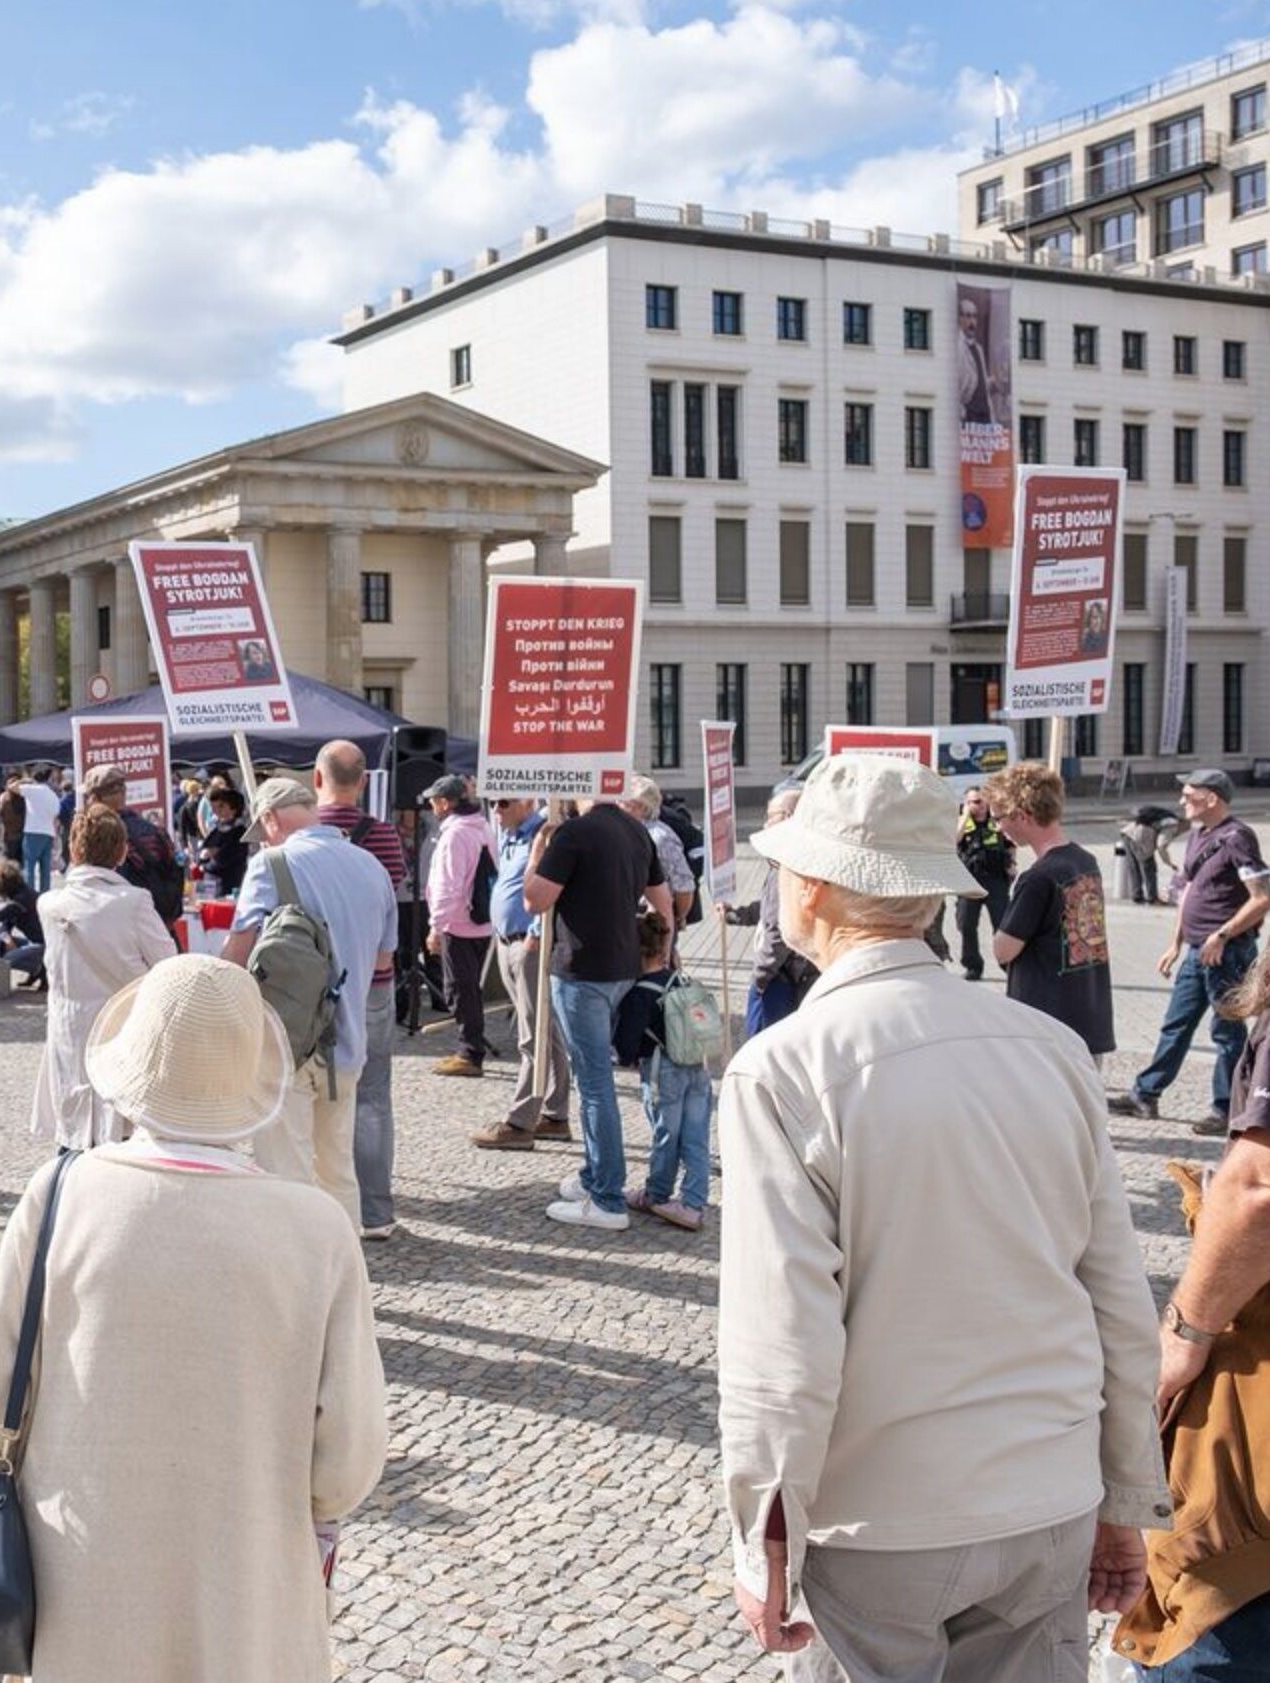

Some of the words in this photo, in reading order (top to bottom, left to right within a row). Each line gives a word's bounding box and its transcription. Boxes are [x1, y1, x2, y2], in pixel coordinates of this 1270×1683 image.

[1032, 512, 1062, 530] FREE
[1065, 508, 1112, 528] BOGDAN
[1039, 528, 1104, 550] SYROTJUK!
[152, 574, 191, 590] FREE
[192, 572, 249, 587] BOGDAN
[166, 586, 243, 604] SYROTJUK!
[506, 618, 554, 631] STOPPT
[558, 618, 585, 630] DEN
[587, 617, 625, 630] KRIEG
[516, 639, 566, 654] Против
[568, 637, 614, 651] войны
[521, 659, 564, 674] Проти
[553, 678, 614, 691] Durdurun
[1012, 681, 1086, 697] SOZIALISTISCHE
[176, 702, 262, 715] SOZIALISTISCHE
[513, 721, 546, 734] STOP
[549, 720, 573, 732] THE
[576, 719, 605, 732] WAR
[86, 748, 115, 764] FREE
[117, 743, 160, 760] BOGDAN
[486, 768, 592, 782] SOZIALISTISCHE
[485, 782, 592, 793] GLEICHHEITSPARTEI
